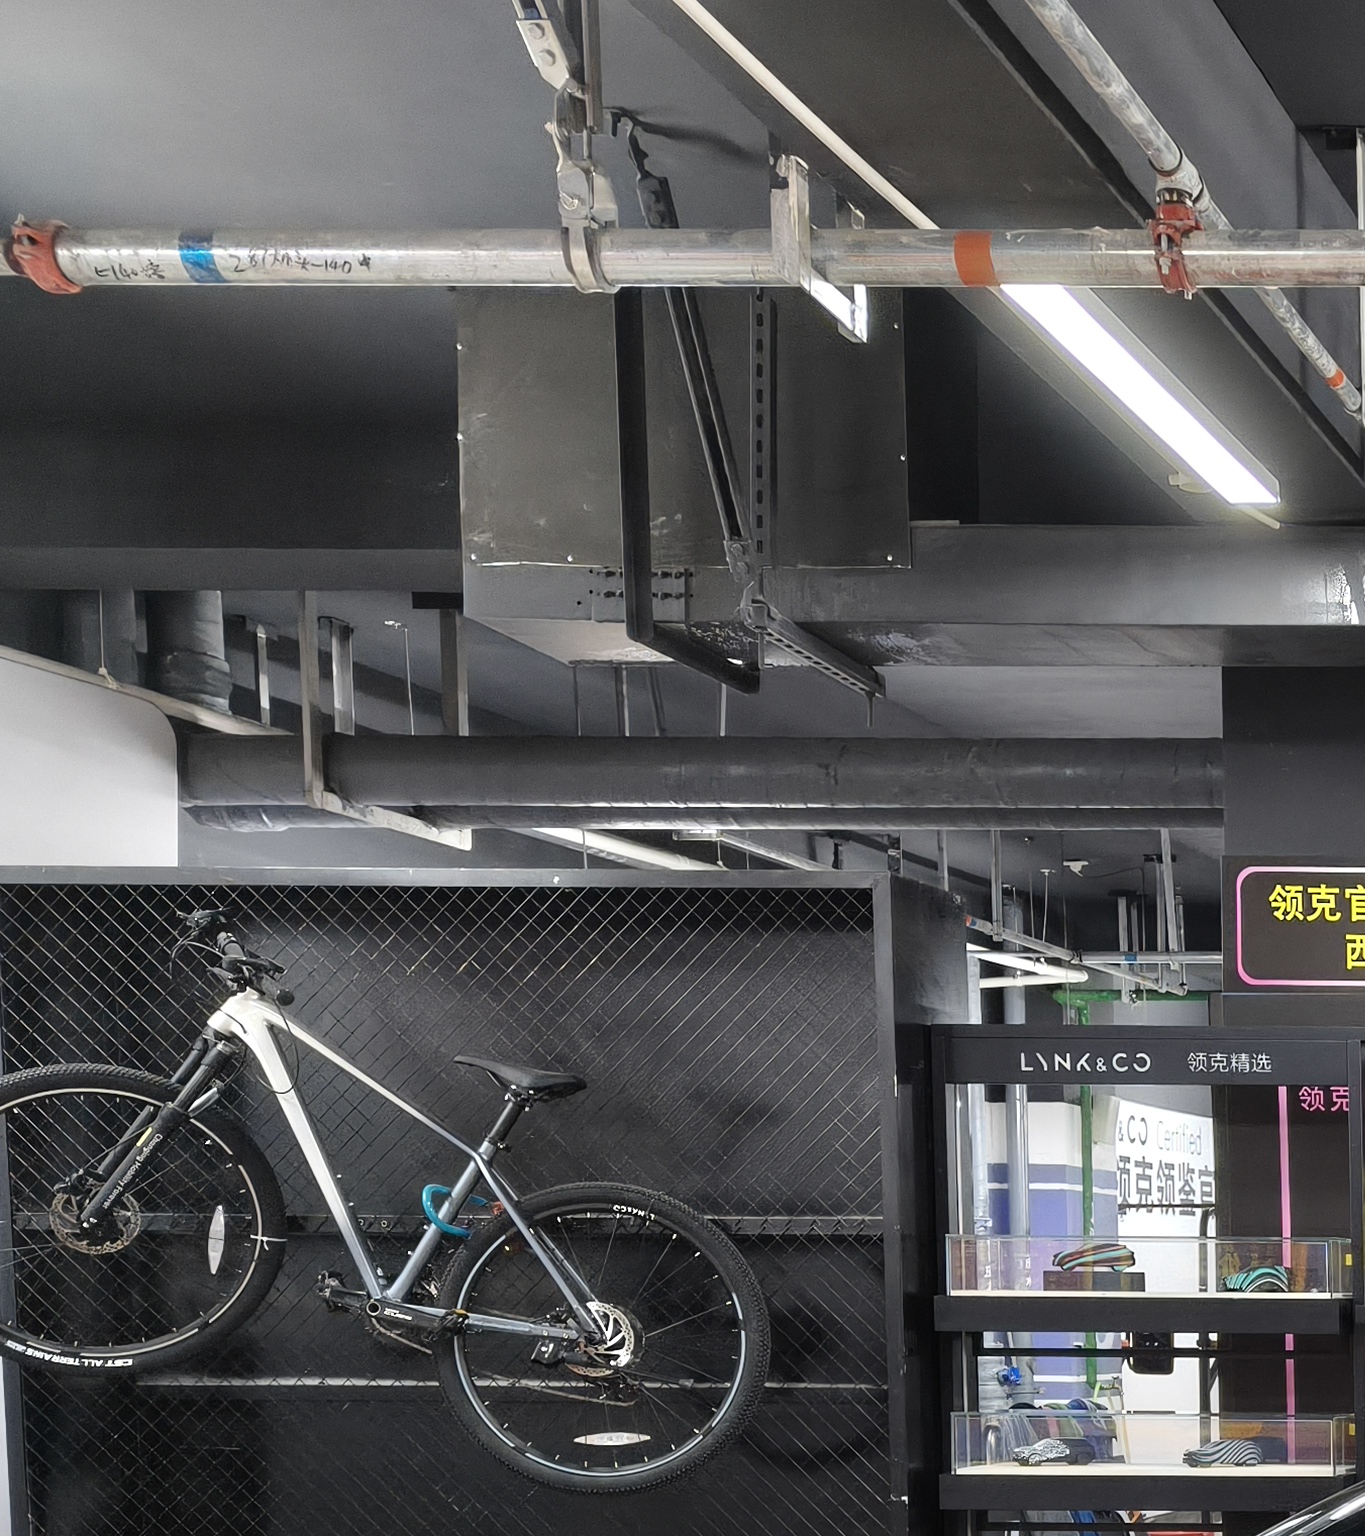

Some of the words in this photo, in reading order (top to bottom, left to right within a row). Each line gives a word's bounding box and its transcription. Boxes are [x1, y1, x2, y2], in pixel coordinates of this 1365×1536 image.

[1020, 1052, 1151, 1073] LYNK&CO
[1187, 1052, 1272, 1073] 领克精选
[1156, 1121, 1202, 1155] Certified
[25, 1348, 80, 1366] TERRAINS
[81, 1358, 104, 1367] ALL
